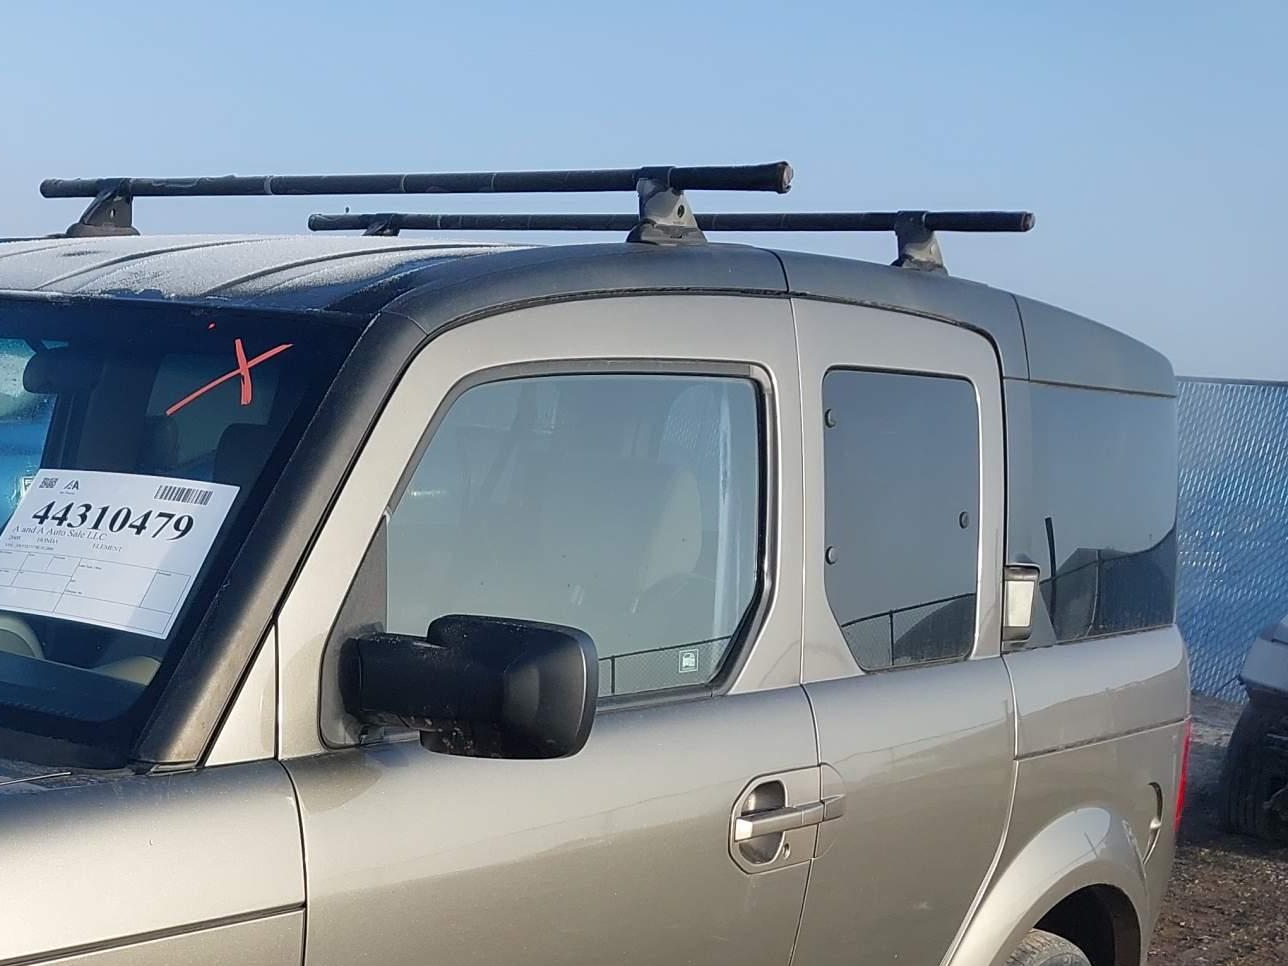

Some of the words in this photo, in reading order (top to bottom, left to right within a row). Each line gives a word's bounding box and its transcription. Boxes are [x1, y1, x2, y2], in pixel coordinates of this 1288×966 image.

[32, 500, 194, 541] 44310479
[20, 526, 36, 534] and
[36, 527, 44, 535] A
[46, 528, 66, 537] Auto
[67, 529, 85, 539] Sale
[87, 531, 108, 542] LLC
[37, 537, 59, 545] HONDA
[92, 543, 123, 553] ELEMENT
